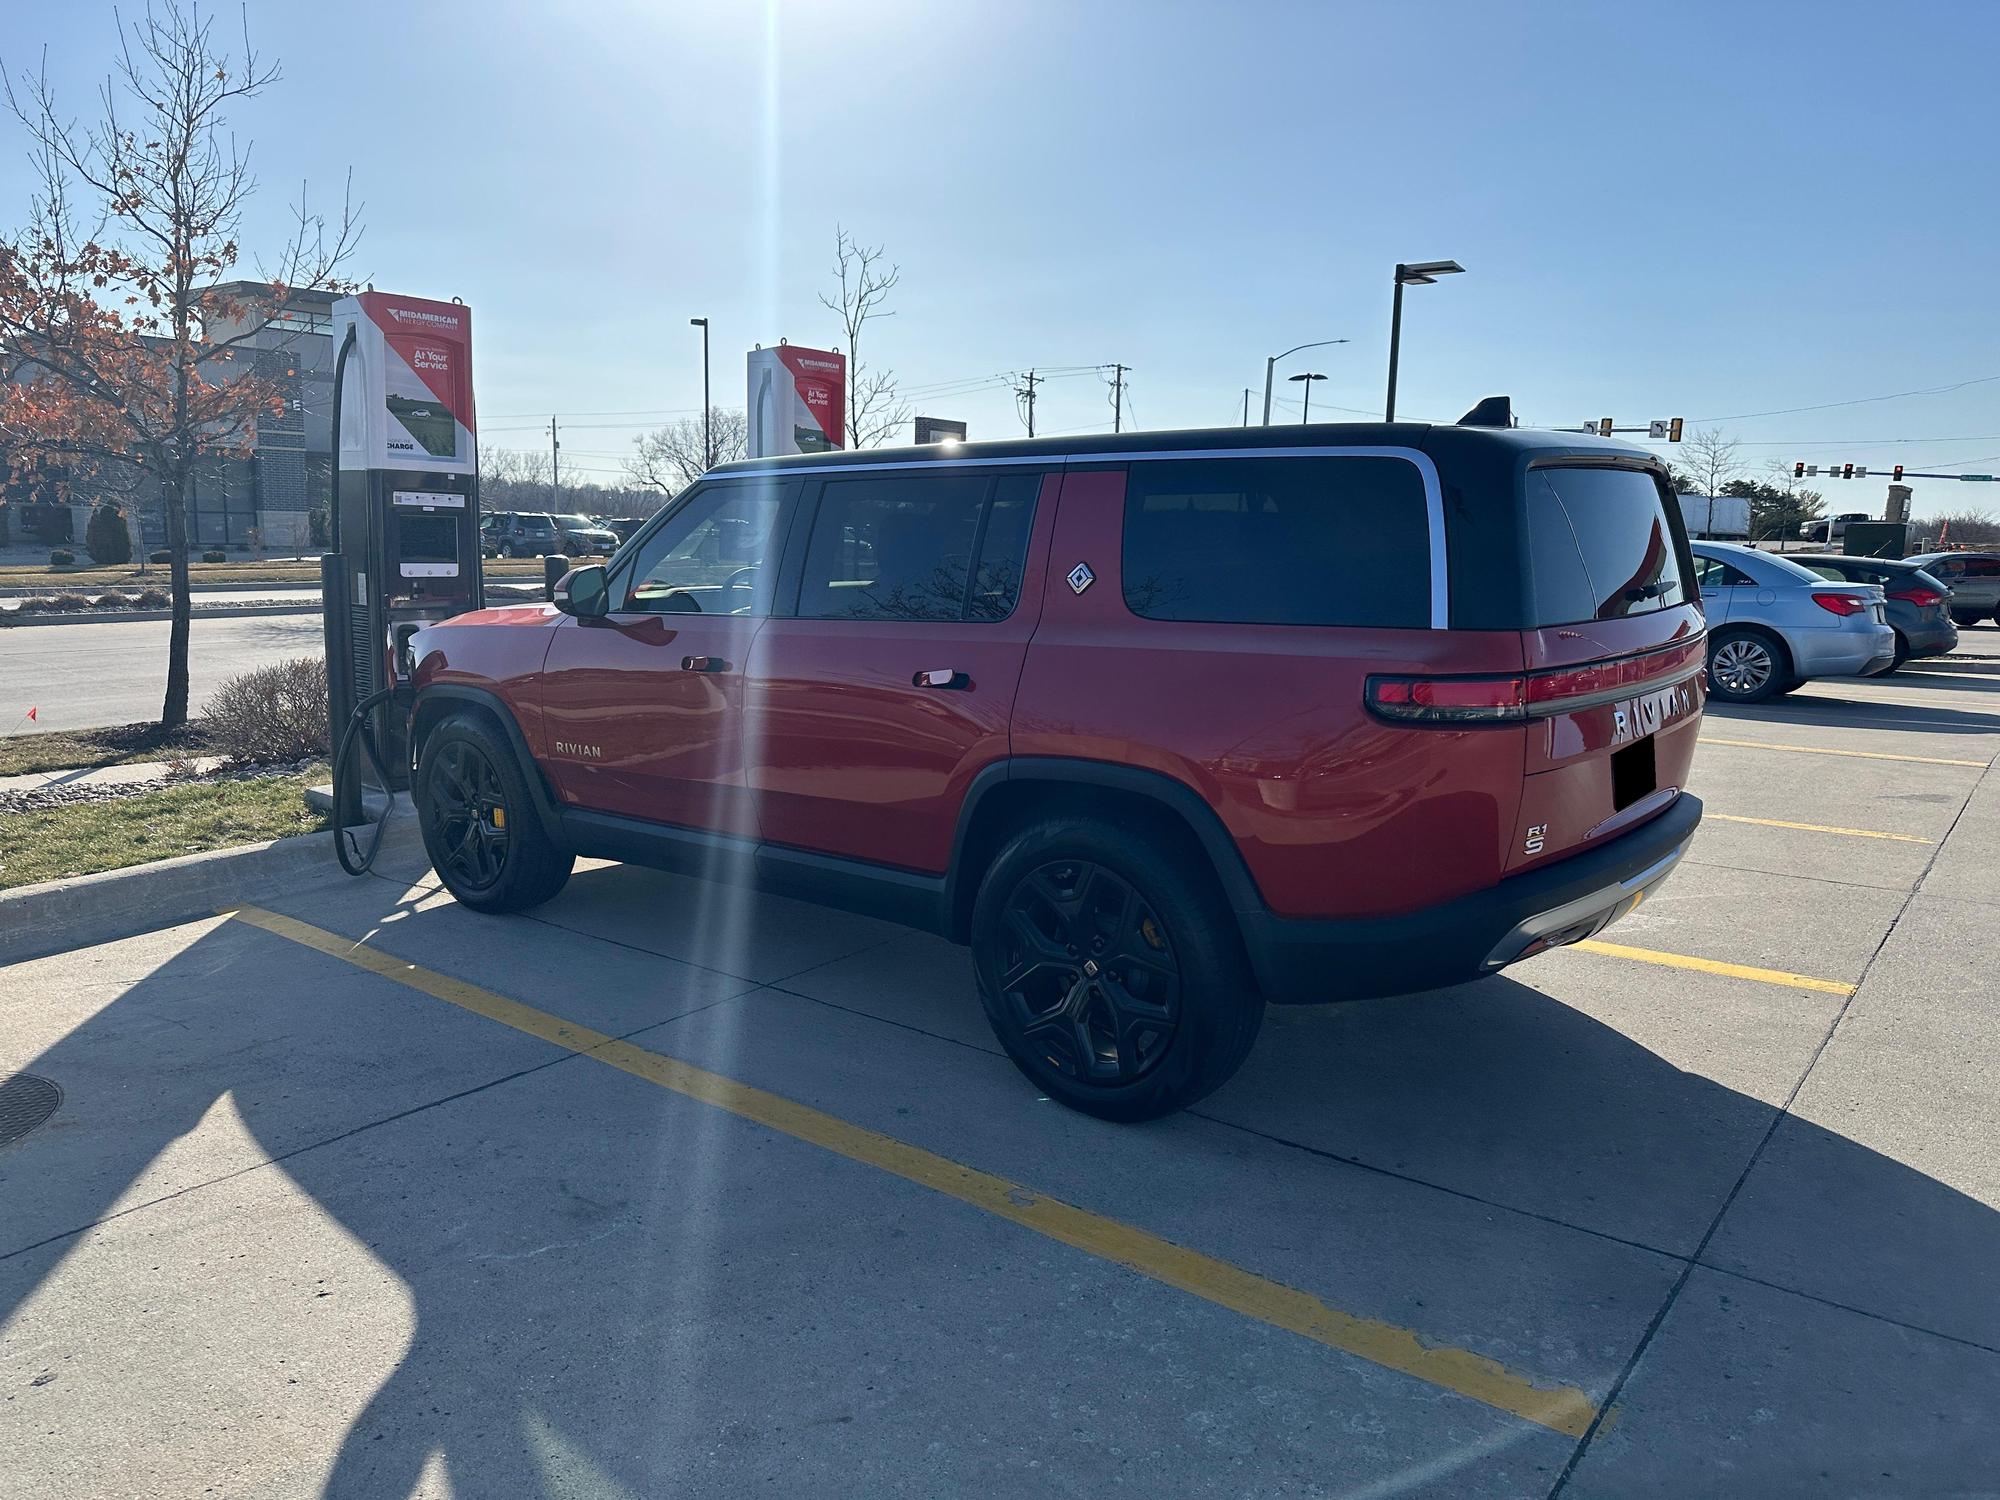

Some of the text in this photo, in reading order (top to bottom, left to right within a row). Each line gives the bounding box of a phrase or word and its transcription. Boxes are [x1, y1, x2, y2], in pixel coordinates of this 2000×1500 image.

[399, 310, 459, 325] MIDAMERICAN
[400, 317, 458, 330] ENERGY COMPANY
[415, 350, 448, 362] At Your
[415, 359, 448, 370] Service
[1613, 688, 1690, 738] RIVIAN
[555, 741, 601, 758] RIVIAN
